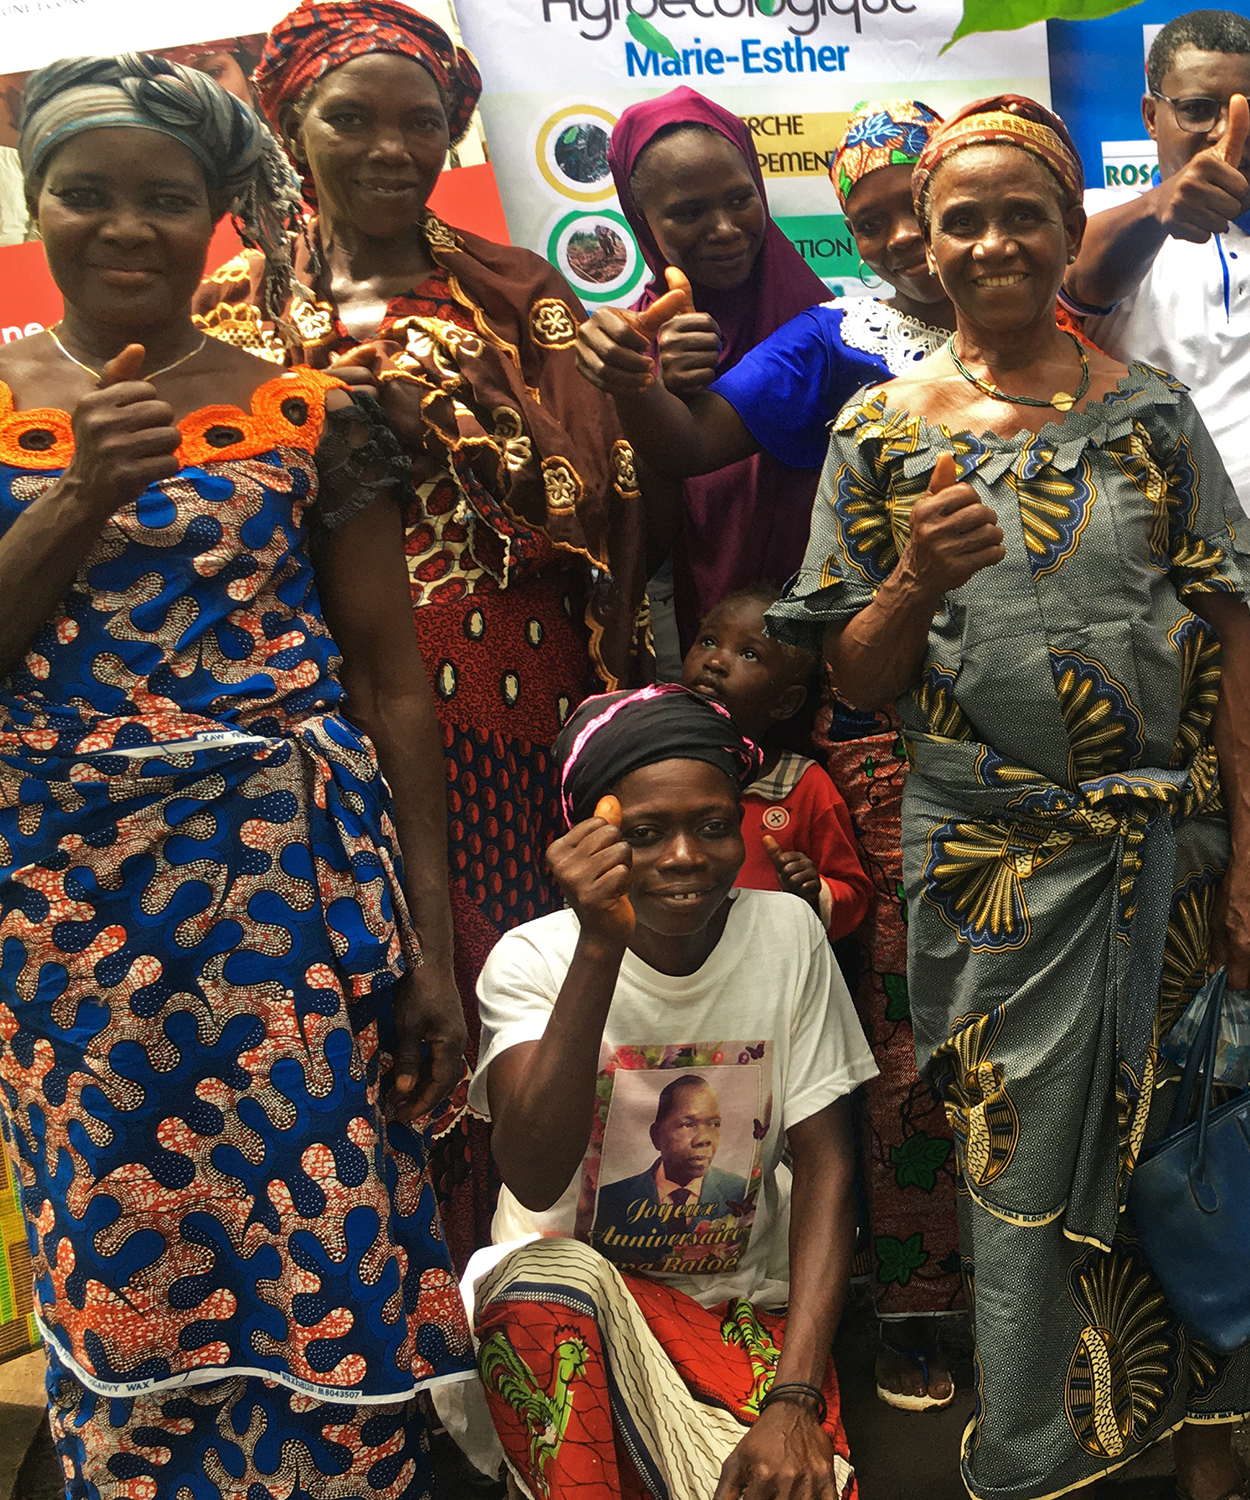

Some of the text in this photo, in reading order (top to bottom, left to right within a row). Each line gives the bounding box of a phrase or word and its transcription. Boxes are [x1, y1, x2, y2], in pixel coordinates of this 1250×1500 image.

[624, 37, 850, 77] Marie-Esther
[626, 1197, 719, 1225] Joyeux
[587, 1225, 744, 1249] Anniversaire
[125, 1381, 150, 1392] WAX
